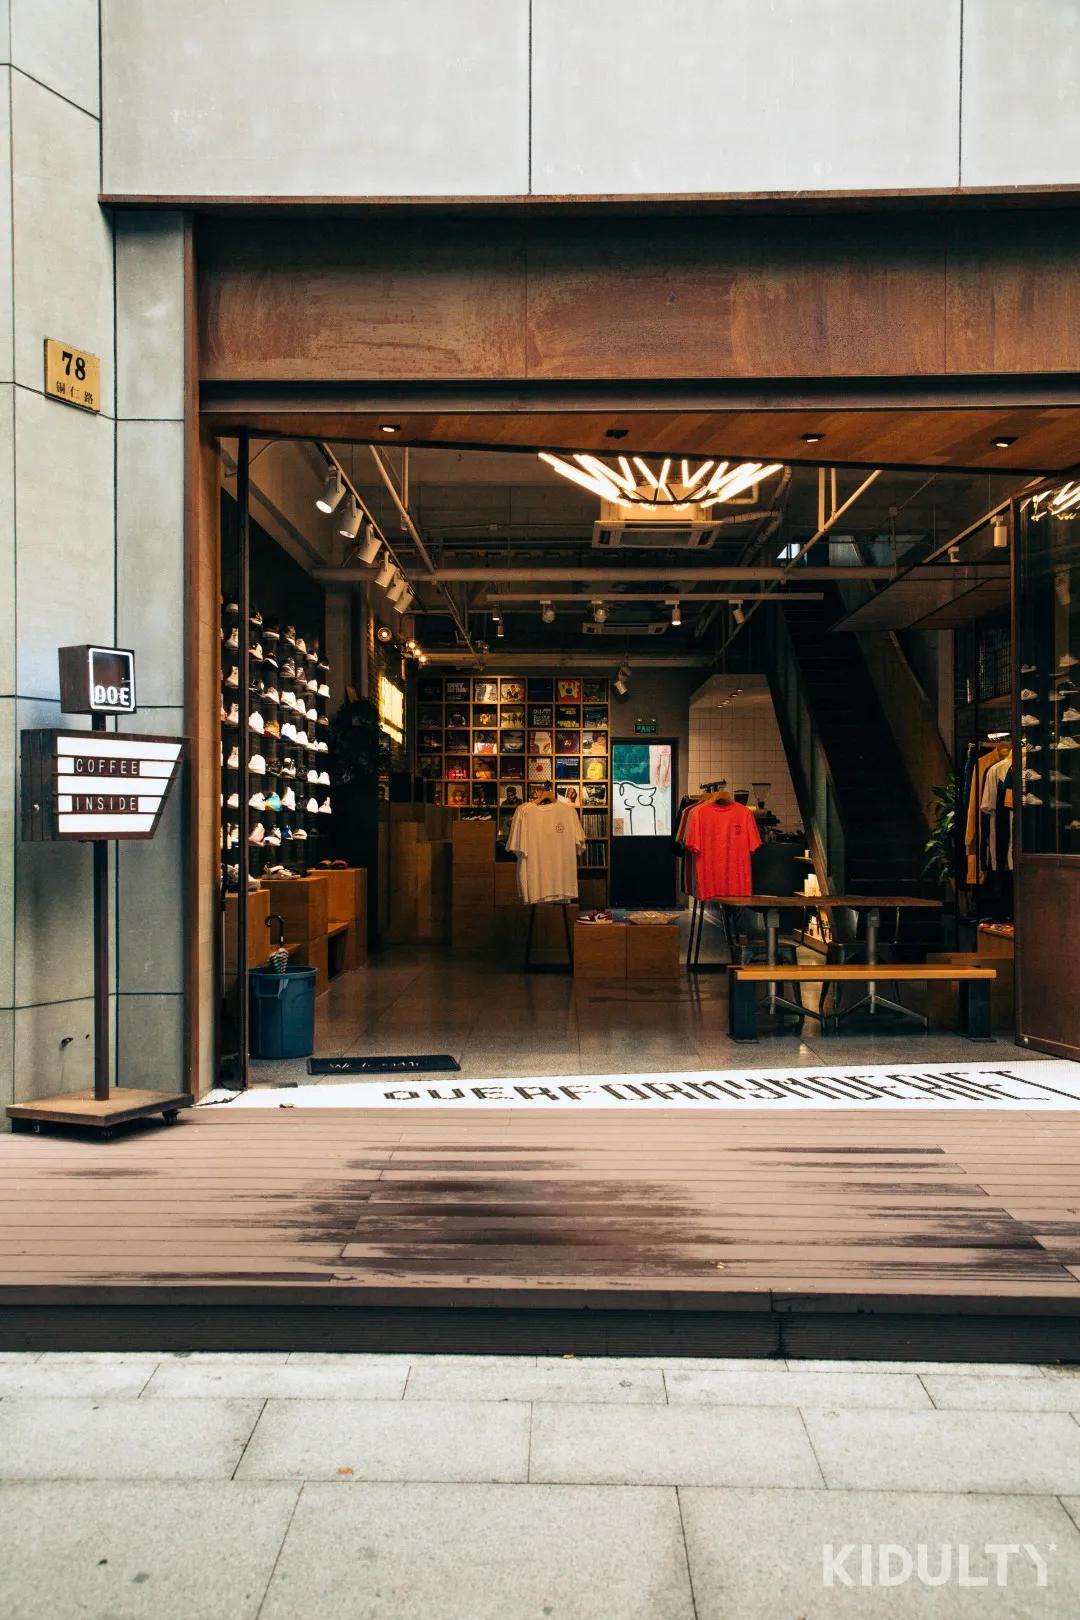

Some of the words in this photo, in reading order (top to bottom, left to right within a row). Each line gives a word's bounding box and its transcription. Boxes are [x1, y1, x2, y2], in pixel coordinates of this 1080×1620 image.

[62, 350, 86, 381] 78
[94, 684, 130, 706] DOE
[76, 758, 138, 775] COFFEE
[76, 796, 137, 811] INSIDE
